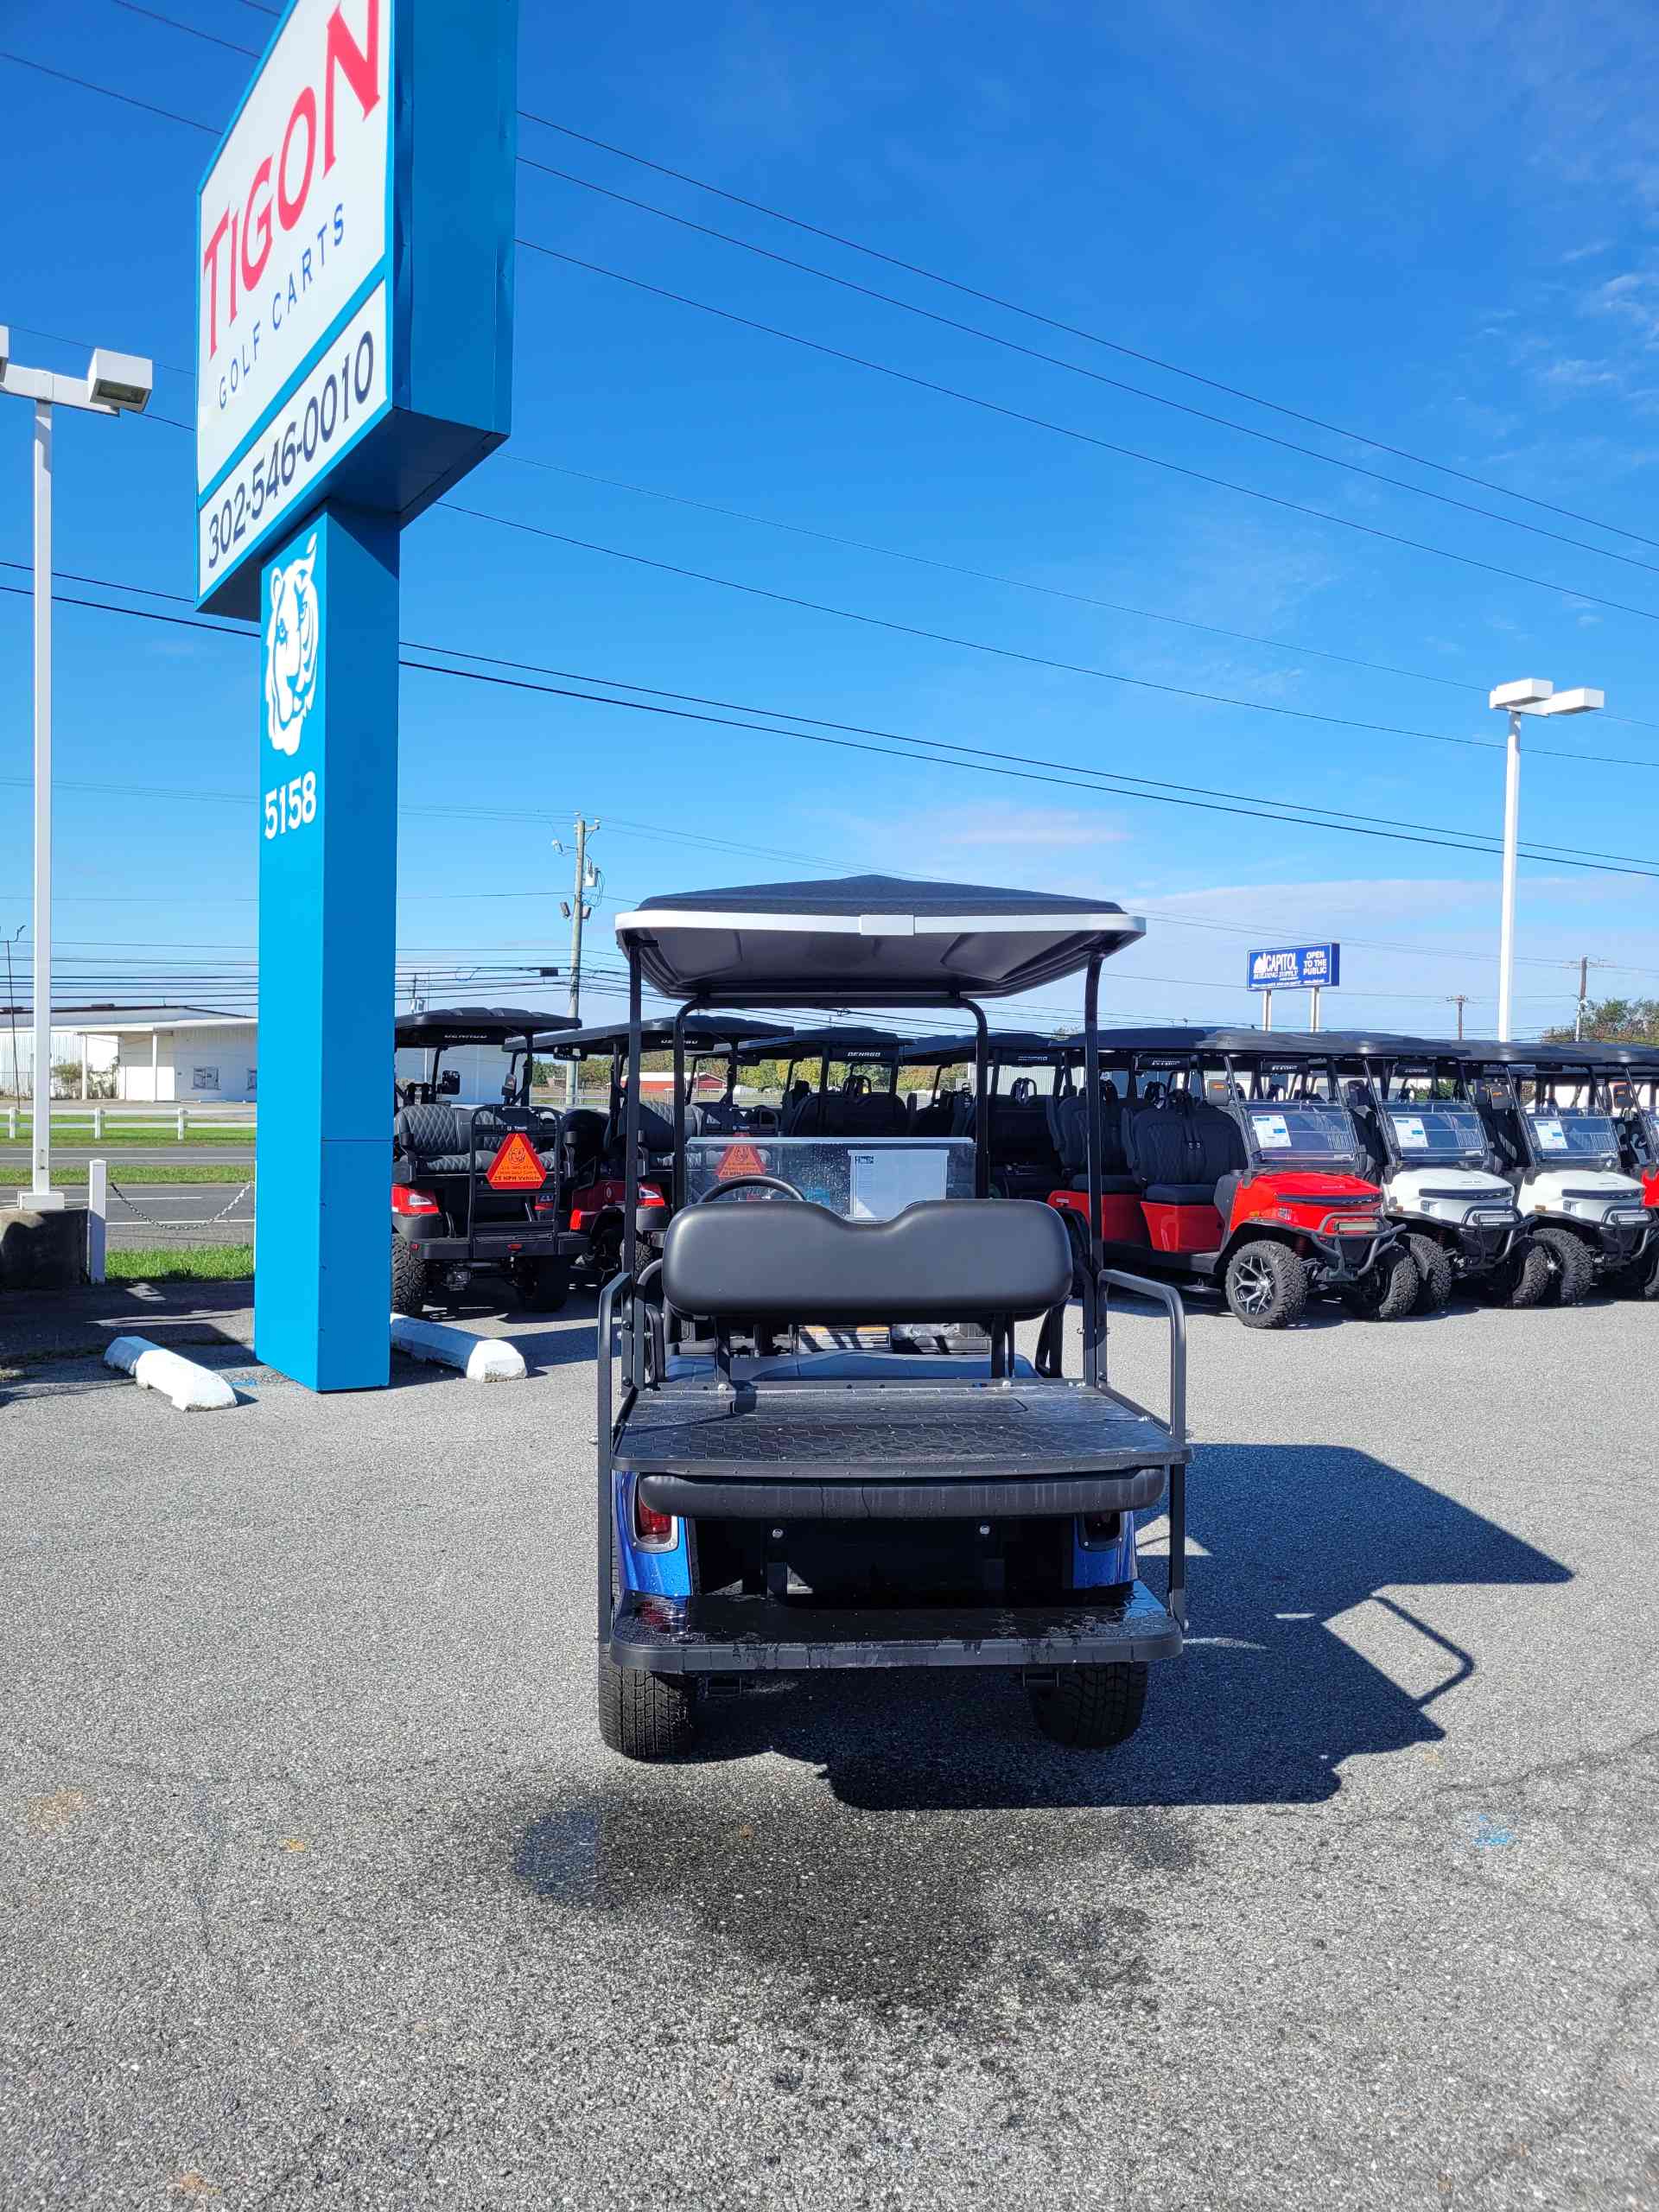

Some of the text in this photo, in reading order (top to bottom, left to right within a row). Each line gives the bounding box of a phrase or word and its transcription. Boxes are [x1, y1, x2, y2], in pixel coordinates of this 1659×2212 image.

[203, 0, 380, 360] TIGON
[219, 202, 344, 410] GOLF CARTS
[207, 330, 374, 569] 302-546-0010
[264, 771, 316, 840] 5158
[1266, 952, 1298, 973] CAPITOL
[1303, 967, 1327, 976] PUBLIC
[1306, 950, 1325, 959] OPEN
[1313, 958, 1327, 967] THE
